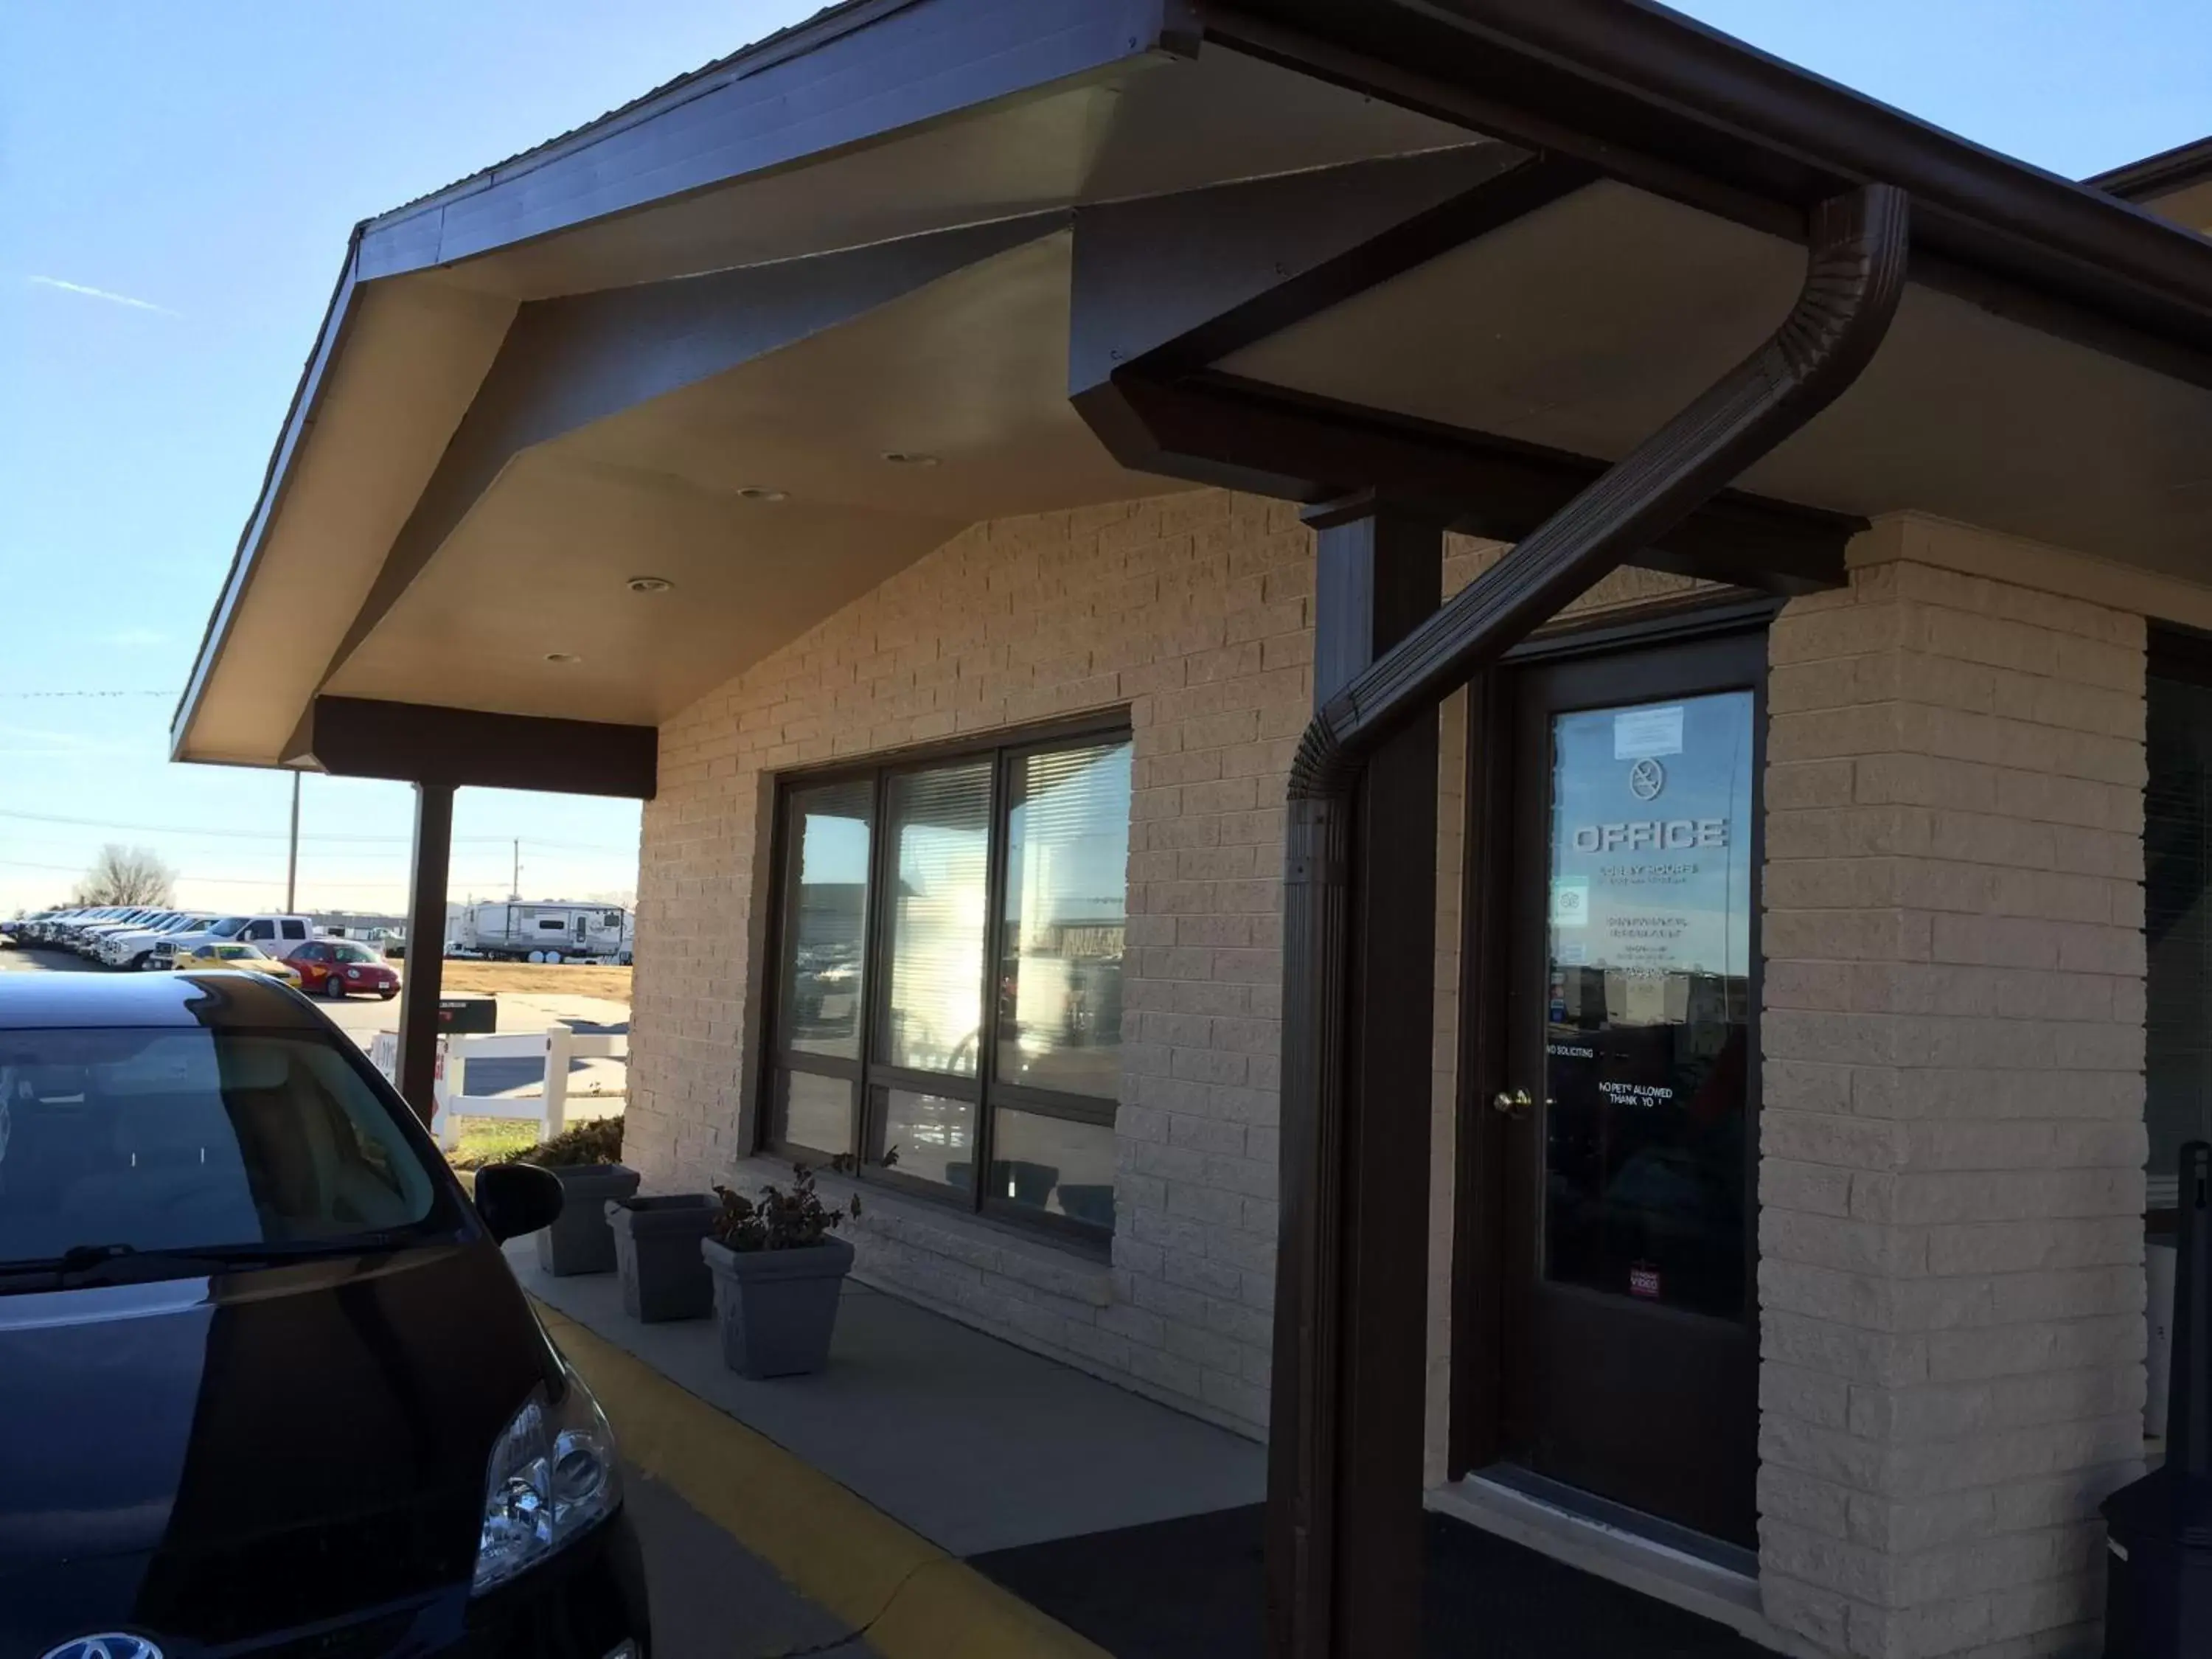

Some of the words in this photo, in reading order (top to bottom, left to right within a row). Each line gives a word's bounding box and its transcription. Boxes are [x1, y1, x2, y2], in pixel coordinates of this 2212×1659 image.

[1573, 818, 1728, 853] OFFICE
[1545, 1044, 1556, 1054] NO
[1557, 1045, 1593, 1058] SOLICITING
[1599, 1082, 1611, 1092] NO
[1634, 1085, 1672, 1098] ALLOWED
[1610, 1093, 1638, 1105] THANK
